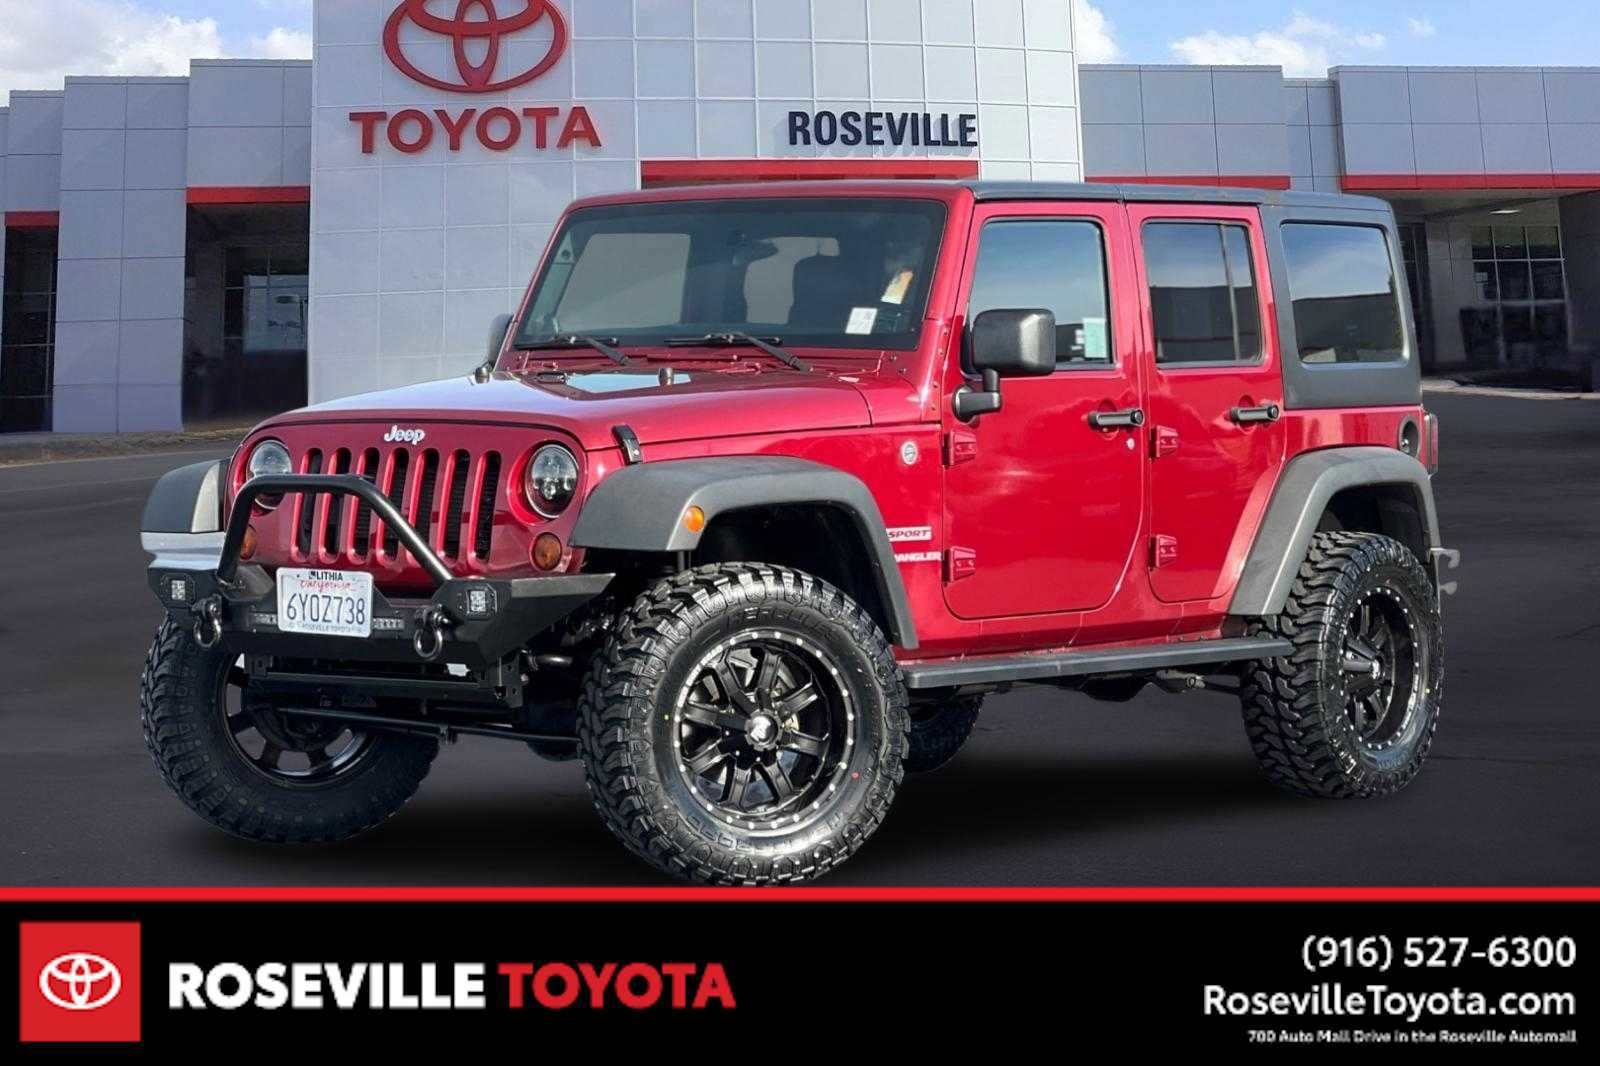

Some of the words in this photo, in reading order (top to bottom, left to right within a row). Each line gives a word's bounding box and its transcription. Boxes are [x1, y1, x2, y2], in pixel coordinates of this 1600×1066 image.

[349, 106, 602, 154] TOYOTA
[789, 111, 978, 147] ROSEVILLE
[384, 424, 426, 446] Jeep
[888, 529, 931, 539] SPORT
[316, 571, 343, 581] LITHIA
